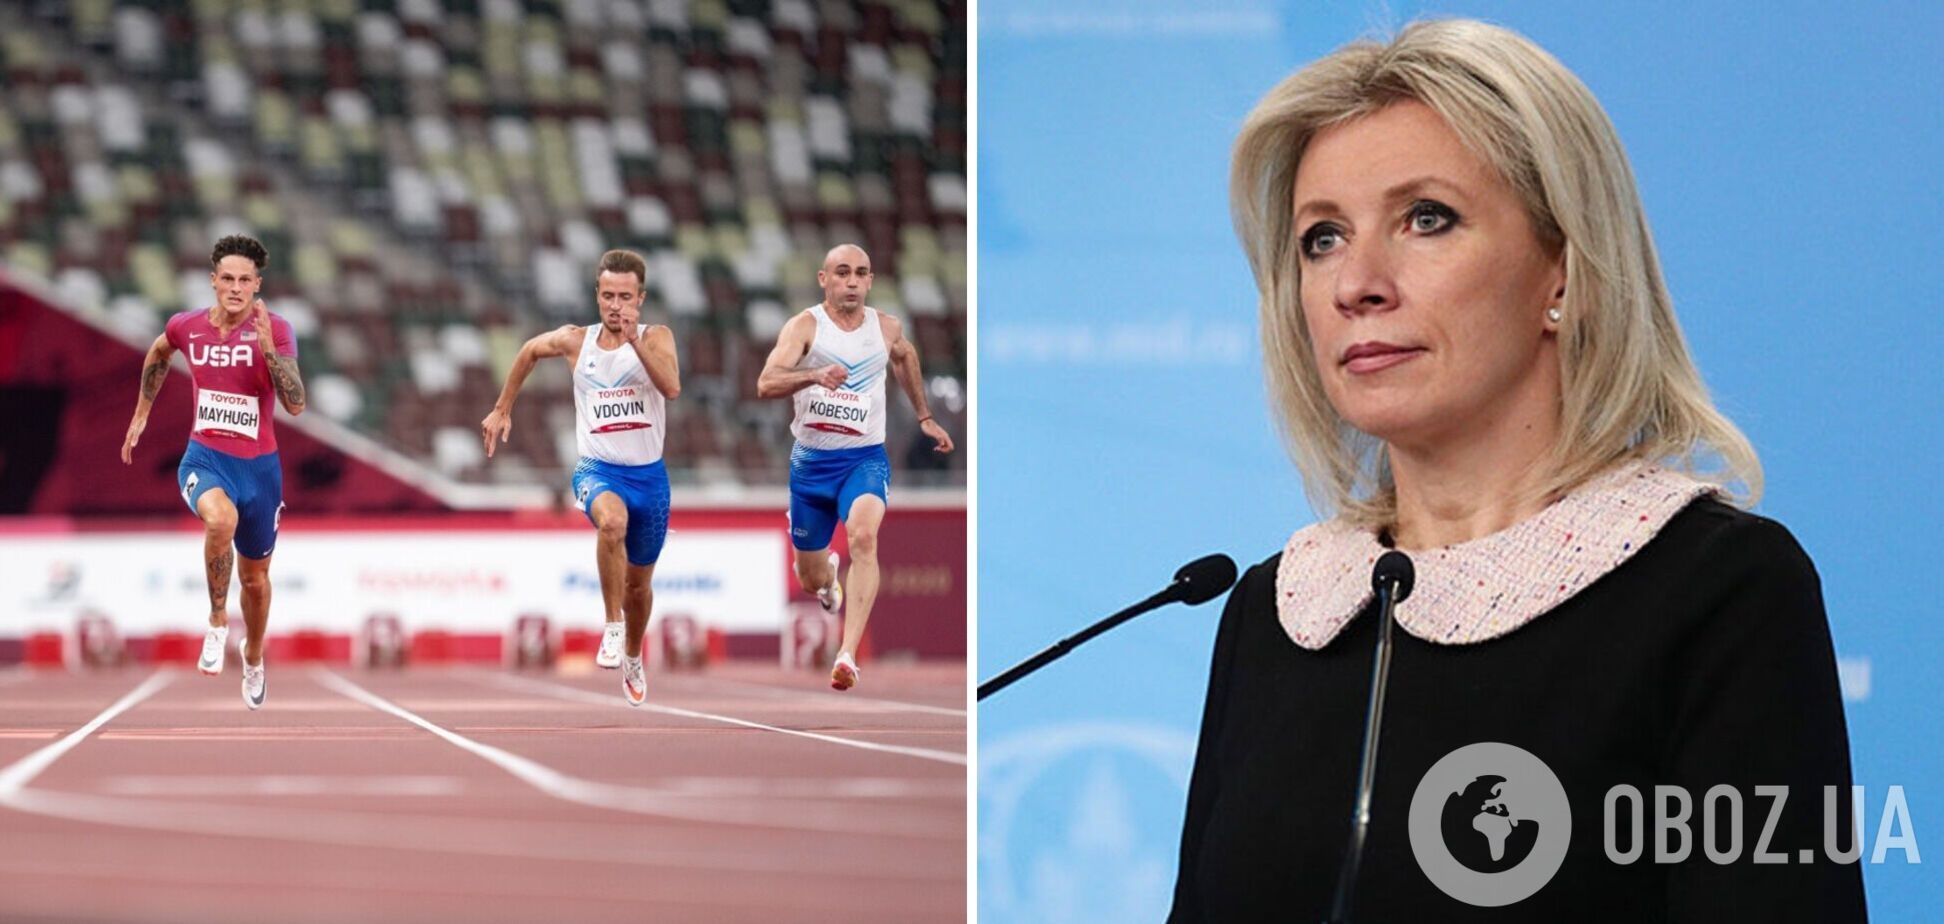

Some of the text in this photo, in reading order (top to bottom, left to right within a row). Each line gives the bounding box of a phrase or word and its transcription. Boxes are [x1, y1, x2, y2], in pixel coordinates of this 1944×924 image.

[189, 343, 253, 367] USA
[210, 393, 248, 406] TOYOTA
[598, 388, 635, 399] TOYOTA
[824, 390, 860, 402] TOYOTA
[198, 405, 258, 428] MAYHUGH
[593, 400, 645, 420] VDOVIN
[808, 400, 868, 423] KOBESOV
